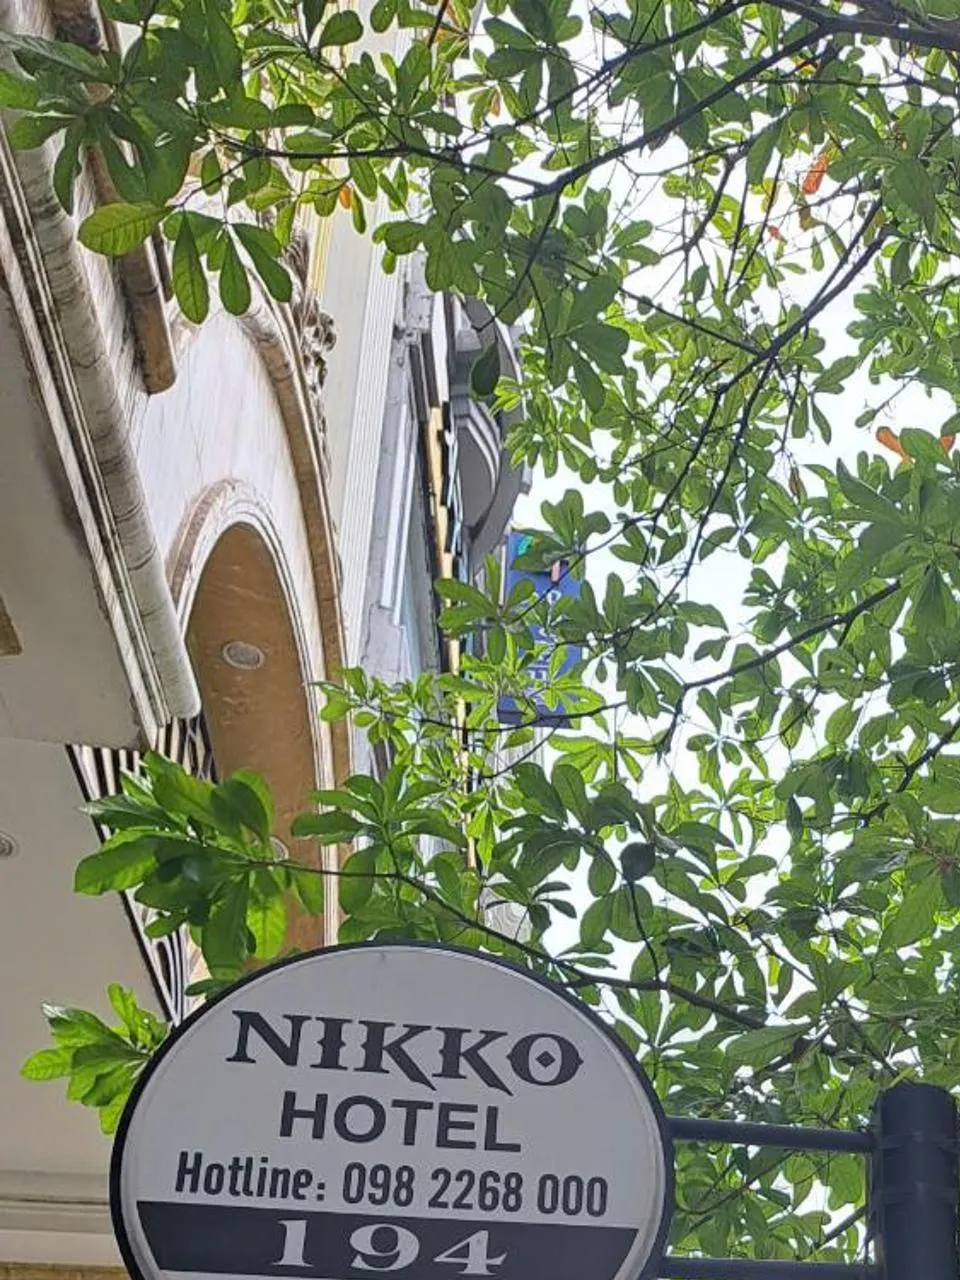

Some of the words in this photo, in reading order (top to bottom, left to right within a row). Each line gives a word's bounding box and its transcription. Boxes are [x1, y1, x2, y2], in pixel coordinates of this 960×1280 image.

[226, 1010, 584, 1096] NIKKO
[279, 1090, 522, 1152] HOTEL
[175, 1150, 326, 1202] Hotline:
[342, 1161, 416, 1208] 098
[427, 1167, 524, 1213] 2268
[536, 1173, 609, 1218] 000
[272, 1219, 507, 1277] 194
